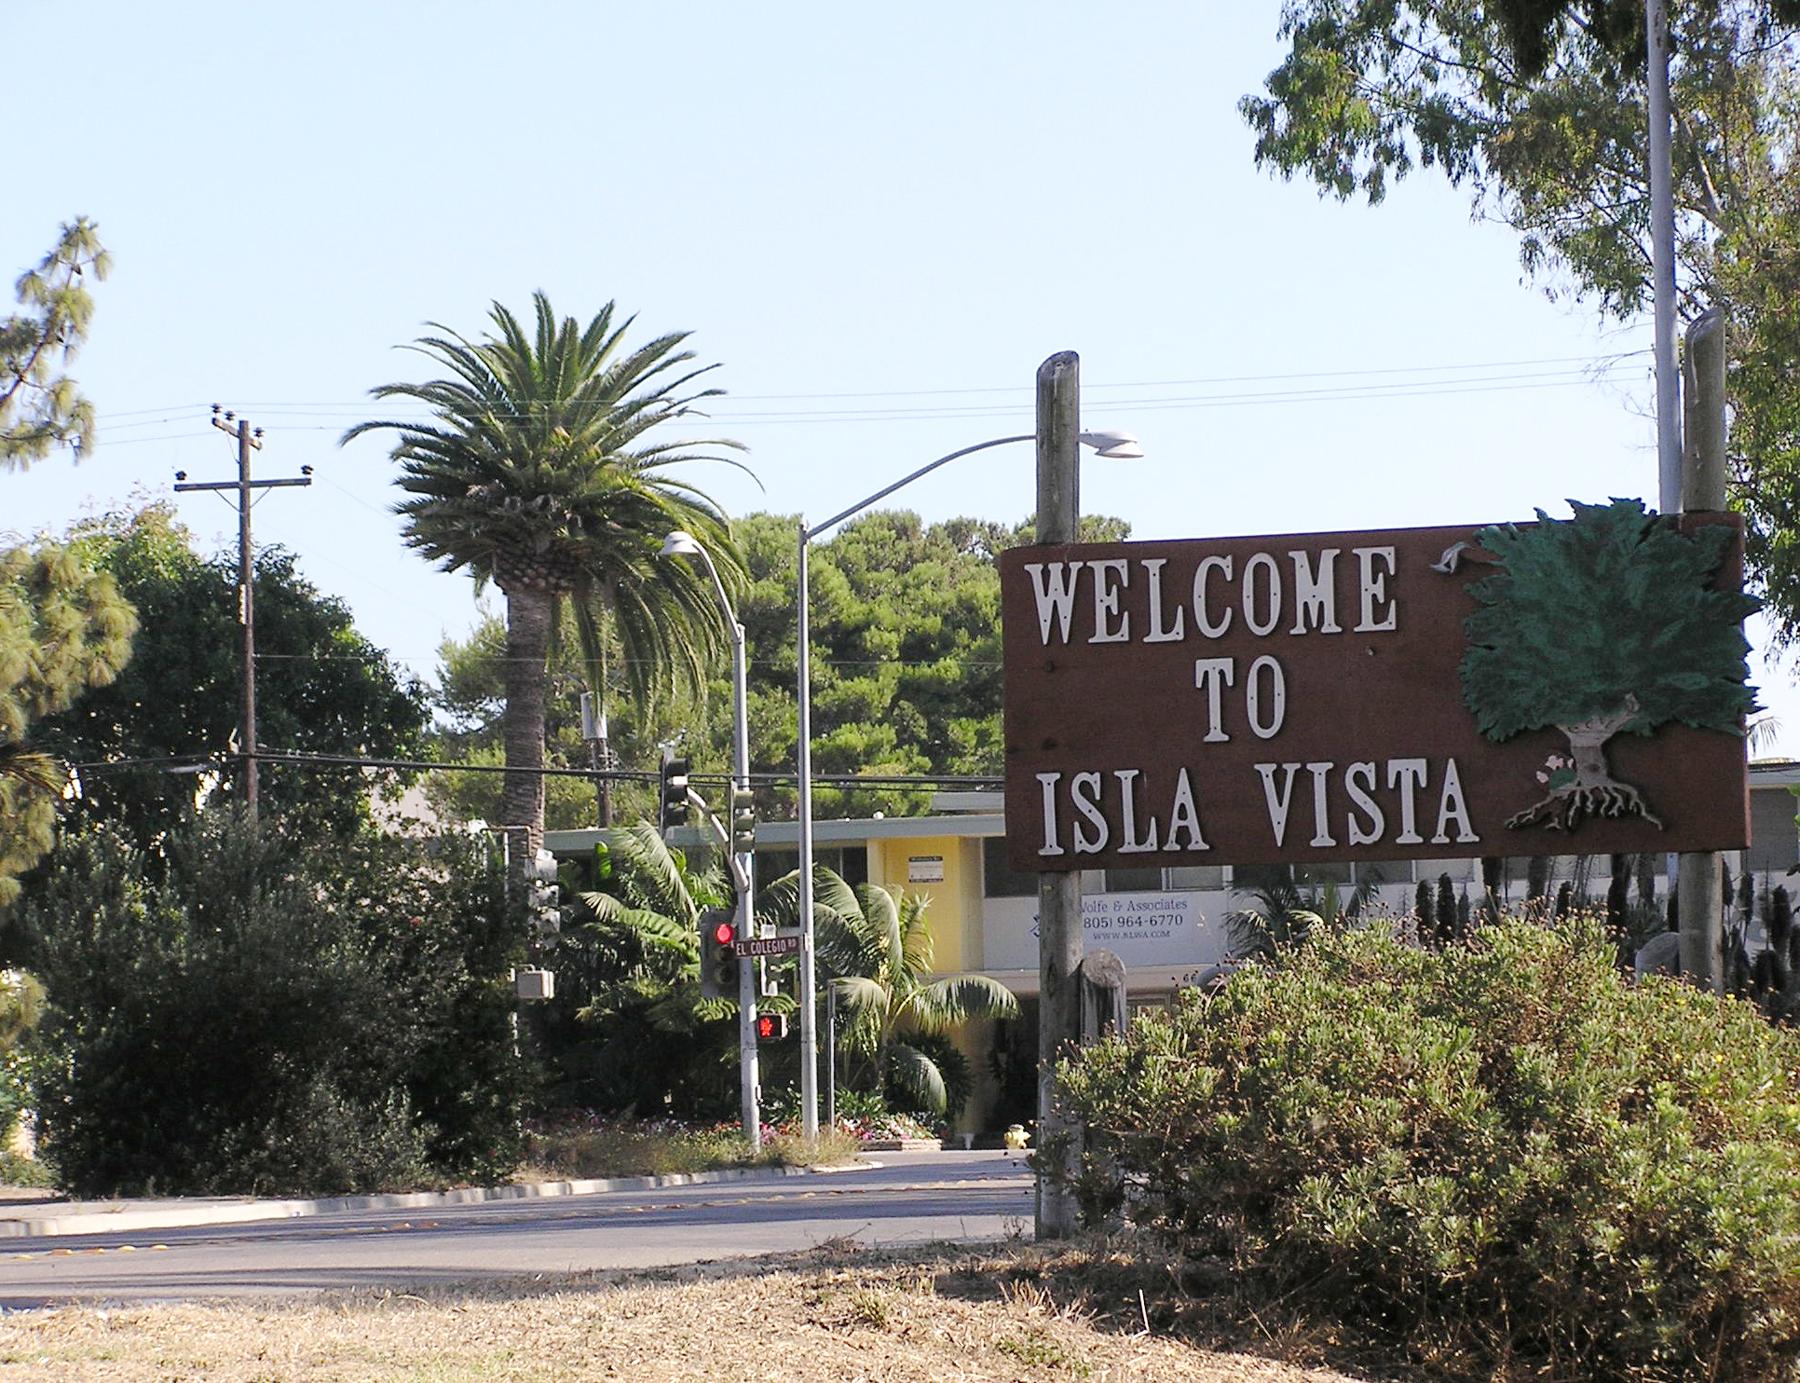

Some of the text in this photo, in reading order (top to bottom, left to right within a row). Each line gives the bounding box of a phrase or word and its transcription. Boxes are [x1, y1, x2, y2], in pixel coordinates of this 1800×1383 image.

[1025, 546, 1398, 646] WELCOME
[1195, 655, 1286, 743] TO
[1036, 757, 1480, 856] ISLA VISTA
[1083, 914, 1183, 929] 805) 964-6770
[1113, 900, 1122, 912] &
[1127, 899, 1188, 912] Associates
[736, 943, 746, 956] EL
[750, 940, 786, 955] COLEGIO
